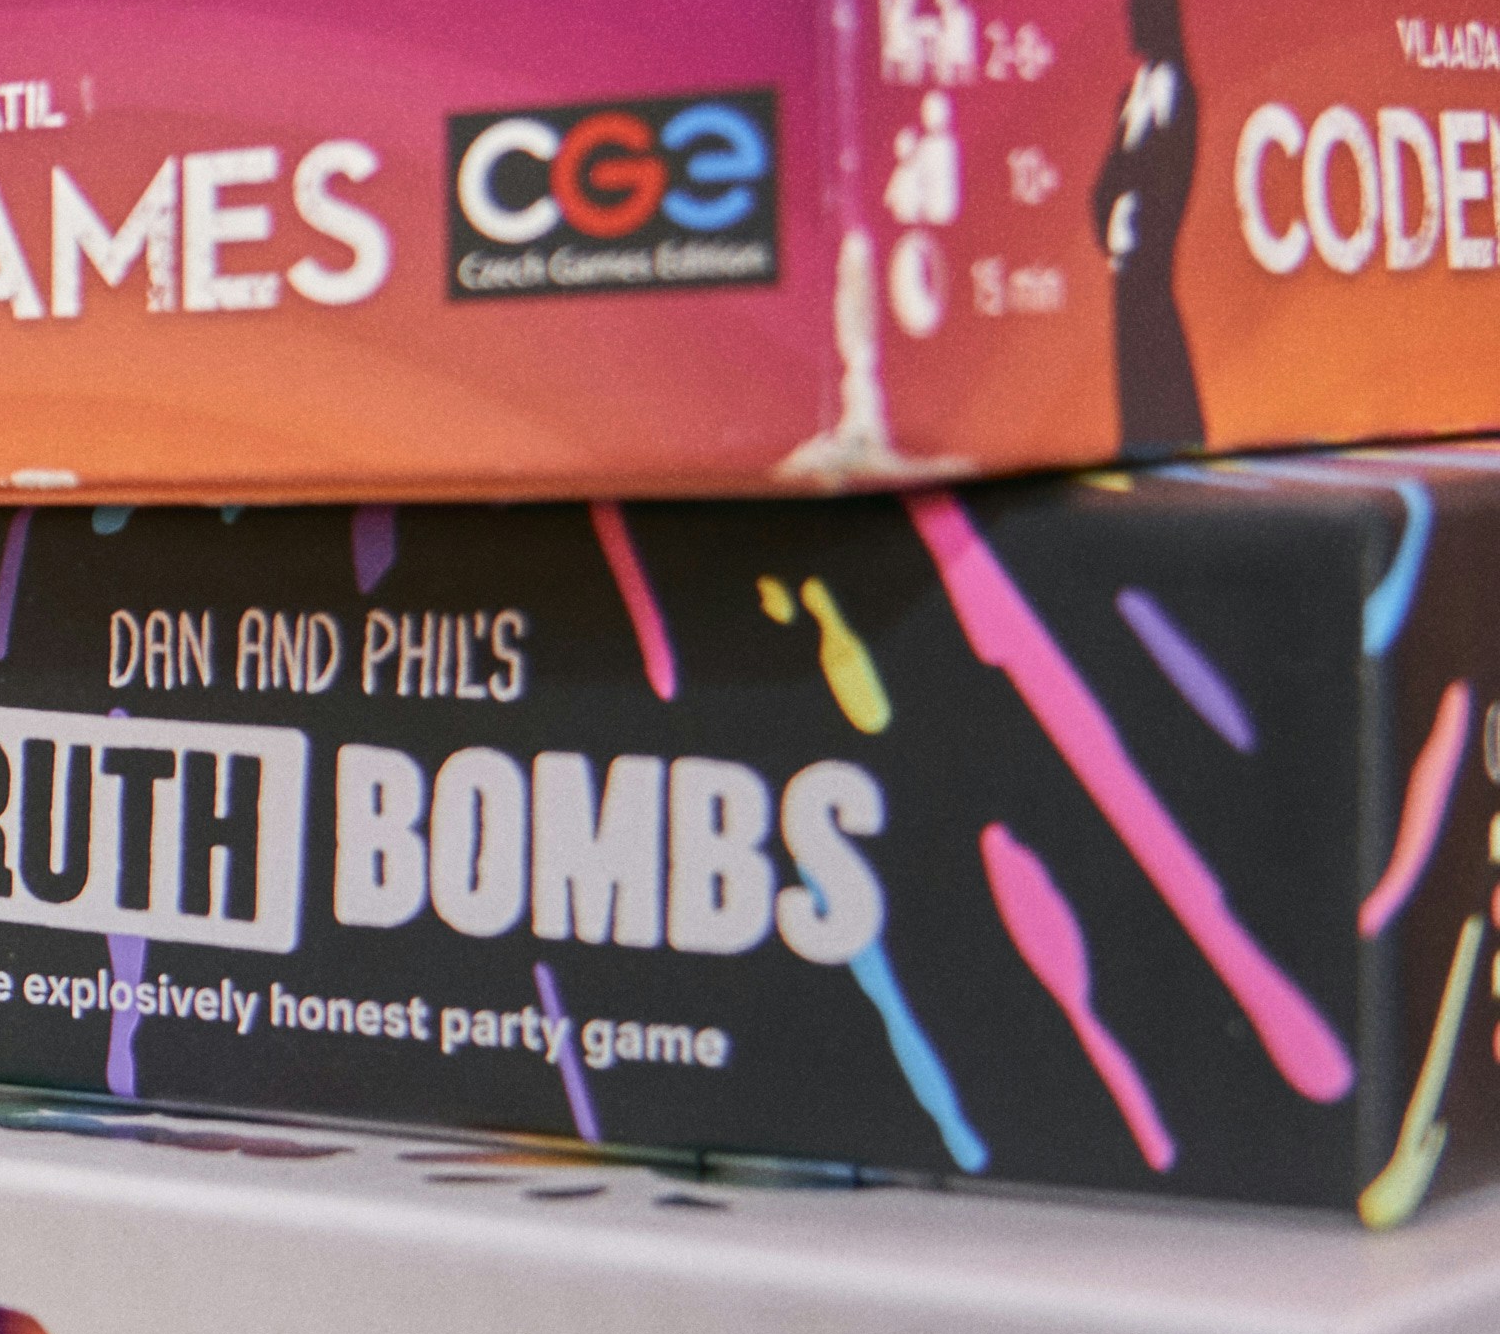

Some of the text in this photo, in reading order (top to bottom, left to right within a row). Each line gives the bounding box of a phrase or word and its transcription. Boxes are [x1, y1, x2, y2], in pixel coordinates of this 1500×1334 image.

[1234, 101, 1500, 274] CODE
[108, 608, 528, 703] DAN AND PHIL'S
[333, 743, 886, 967] BOMBS
[23, 969, 259, 1036] explosively
[270, 983, 428, 1042] honest
[441, 1003, 569, 1064] party
[581, 1017, 732, 1069] game
